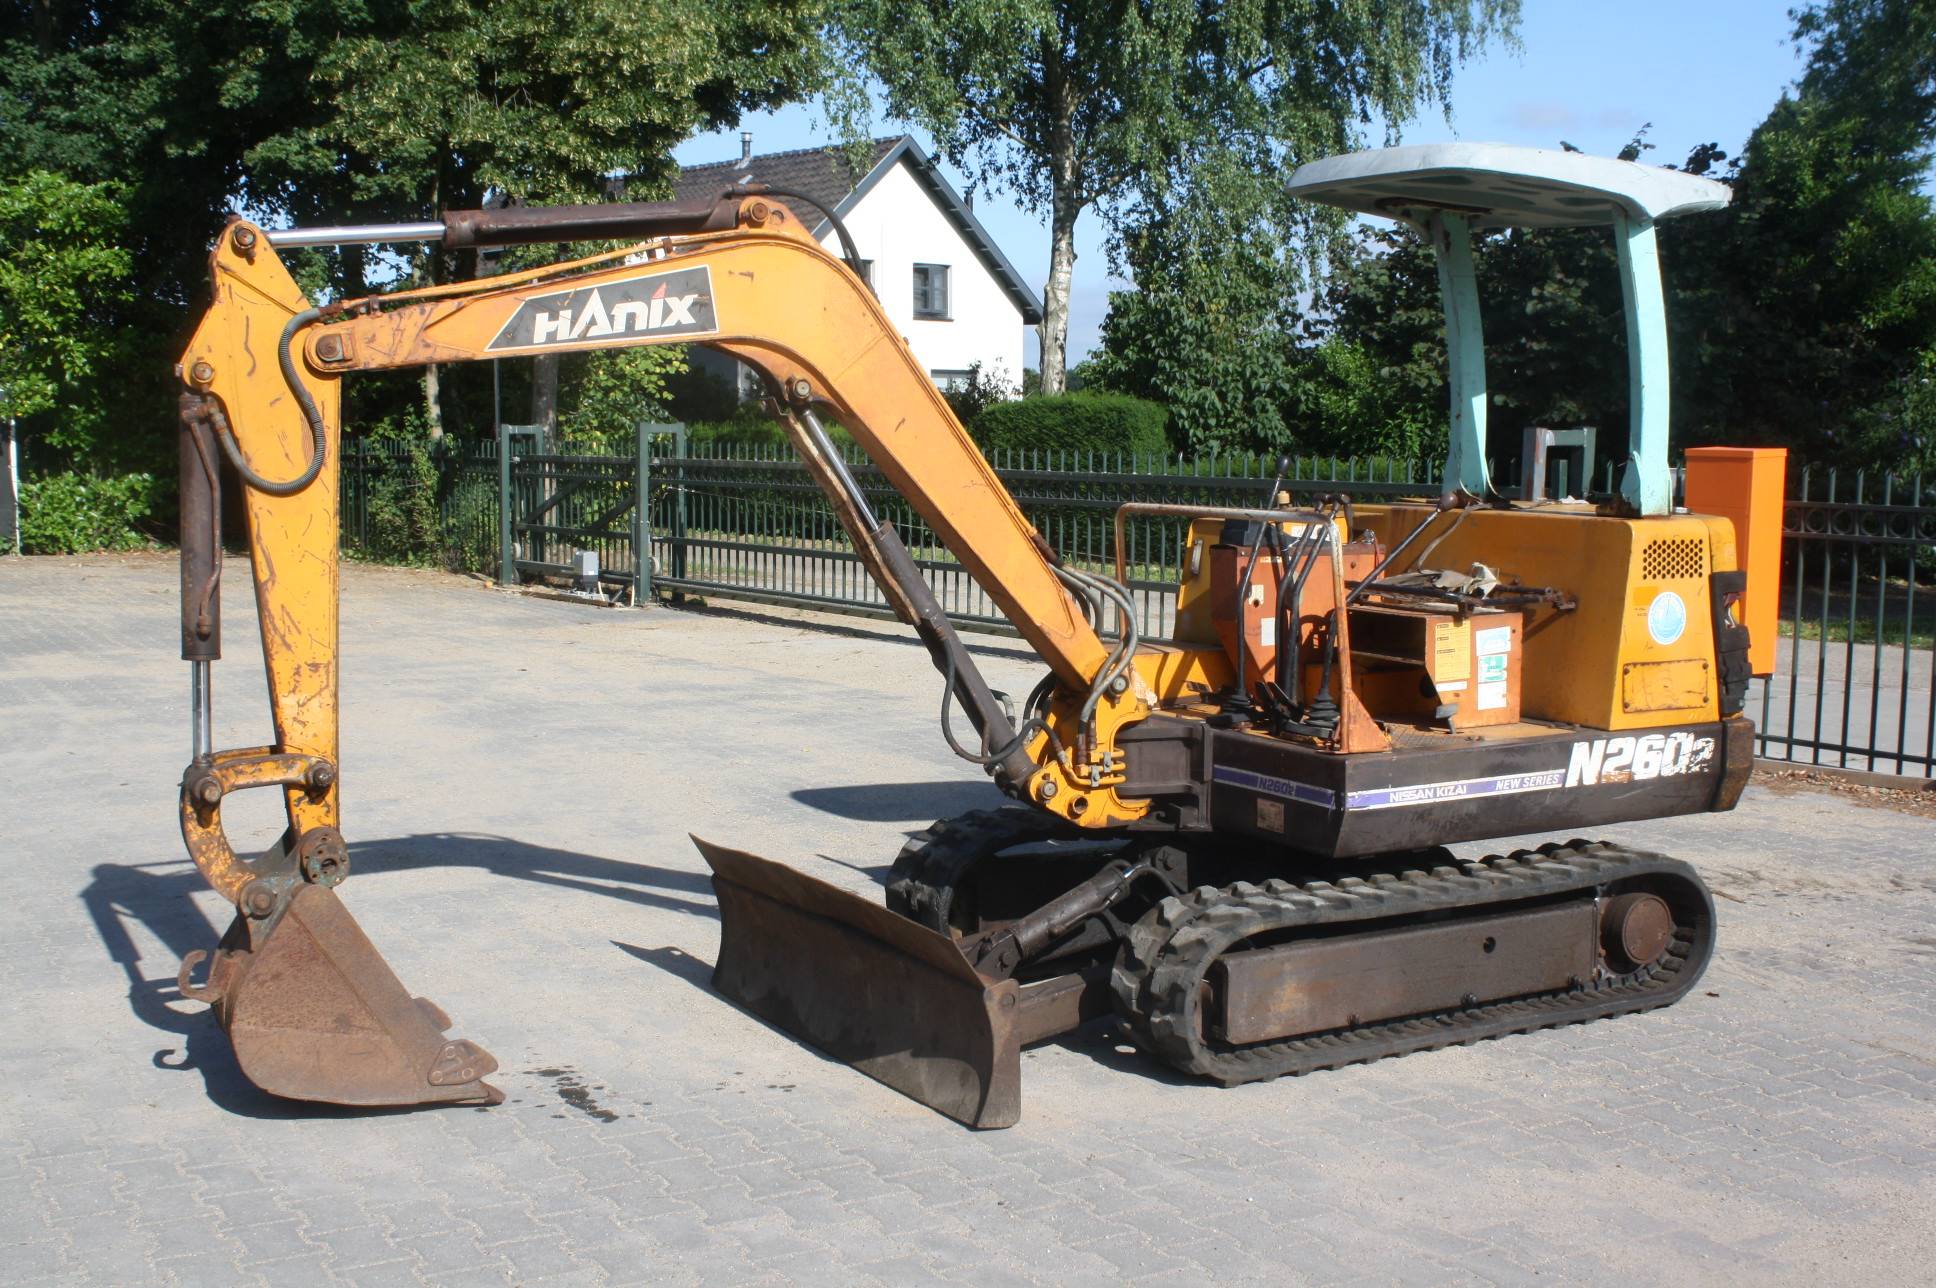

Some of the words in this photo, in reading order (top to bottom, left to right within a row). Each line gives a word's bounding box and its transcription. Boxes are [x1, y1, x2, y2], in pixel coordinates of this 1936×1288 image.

[1495, 778, 1521, 790] NEW
[1522, 773, 1561, 788] SERIES
[1389, 787, 1434, 803] NISSAN
[1436, 784, 1467, 798] KIZAI
